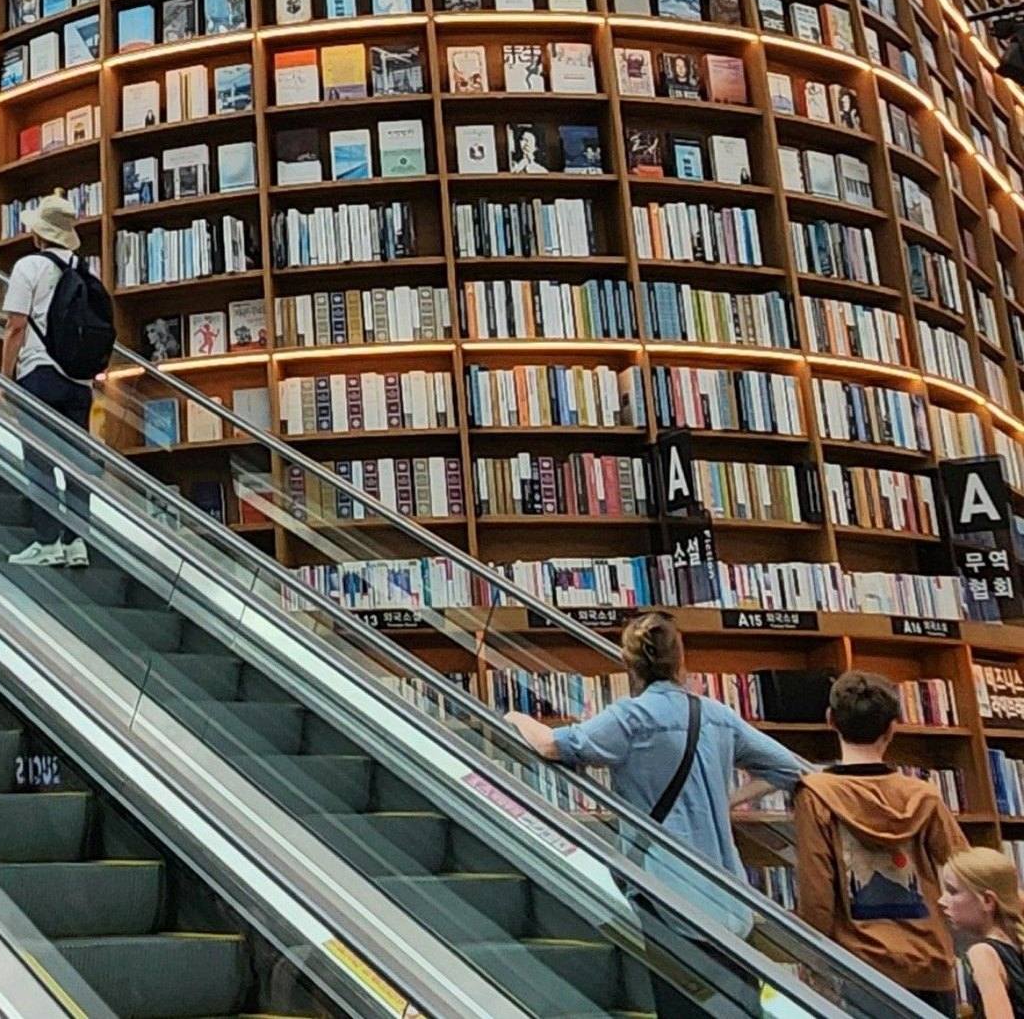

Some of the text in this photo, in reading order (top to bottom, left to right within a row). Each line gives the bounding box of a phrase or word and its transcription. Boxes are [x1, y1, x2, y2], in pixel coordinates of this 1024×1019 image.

[667, 445, 691, 502] A
[959, 472, 1002, 525] A
[673, 535, 702, 568] 소설
[964, 549, 1011, 574] 무역
[967, 576, 1014, 601] 협회
[738, 612, 763, 628] A15
